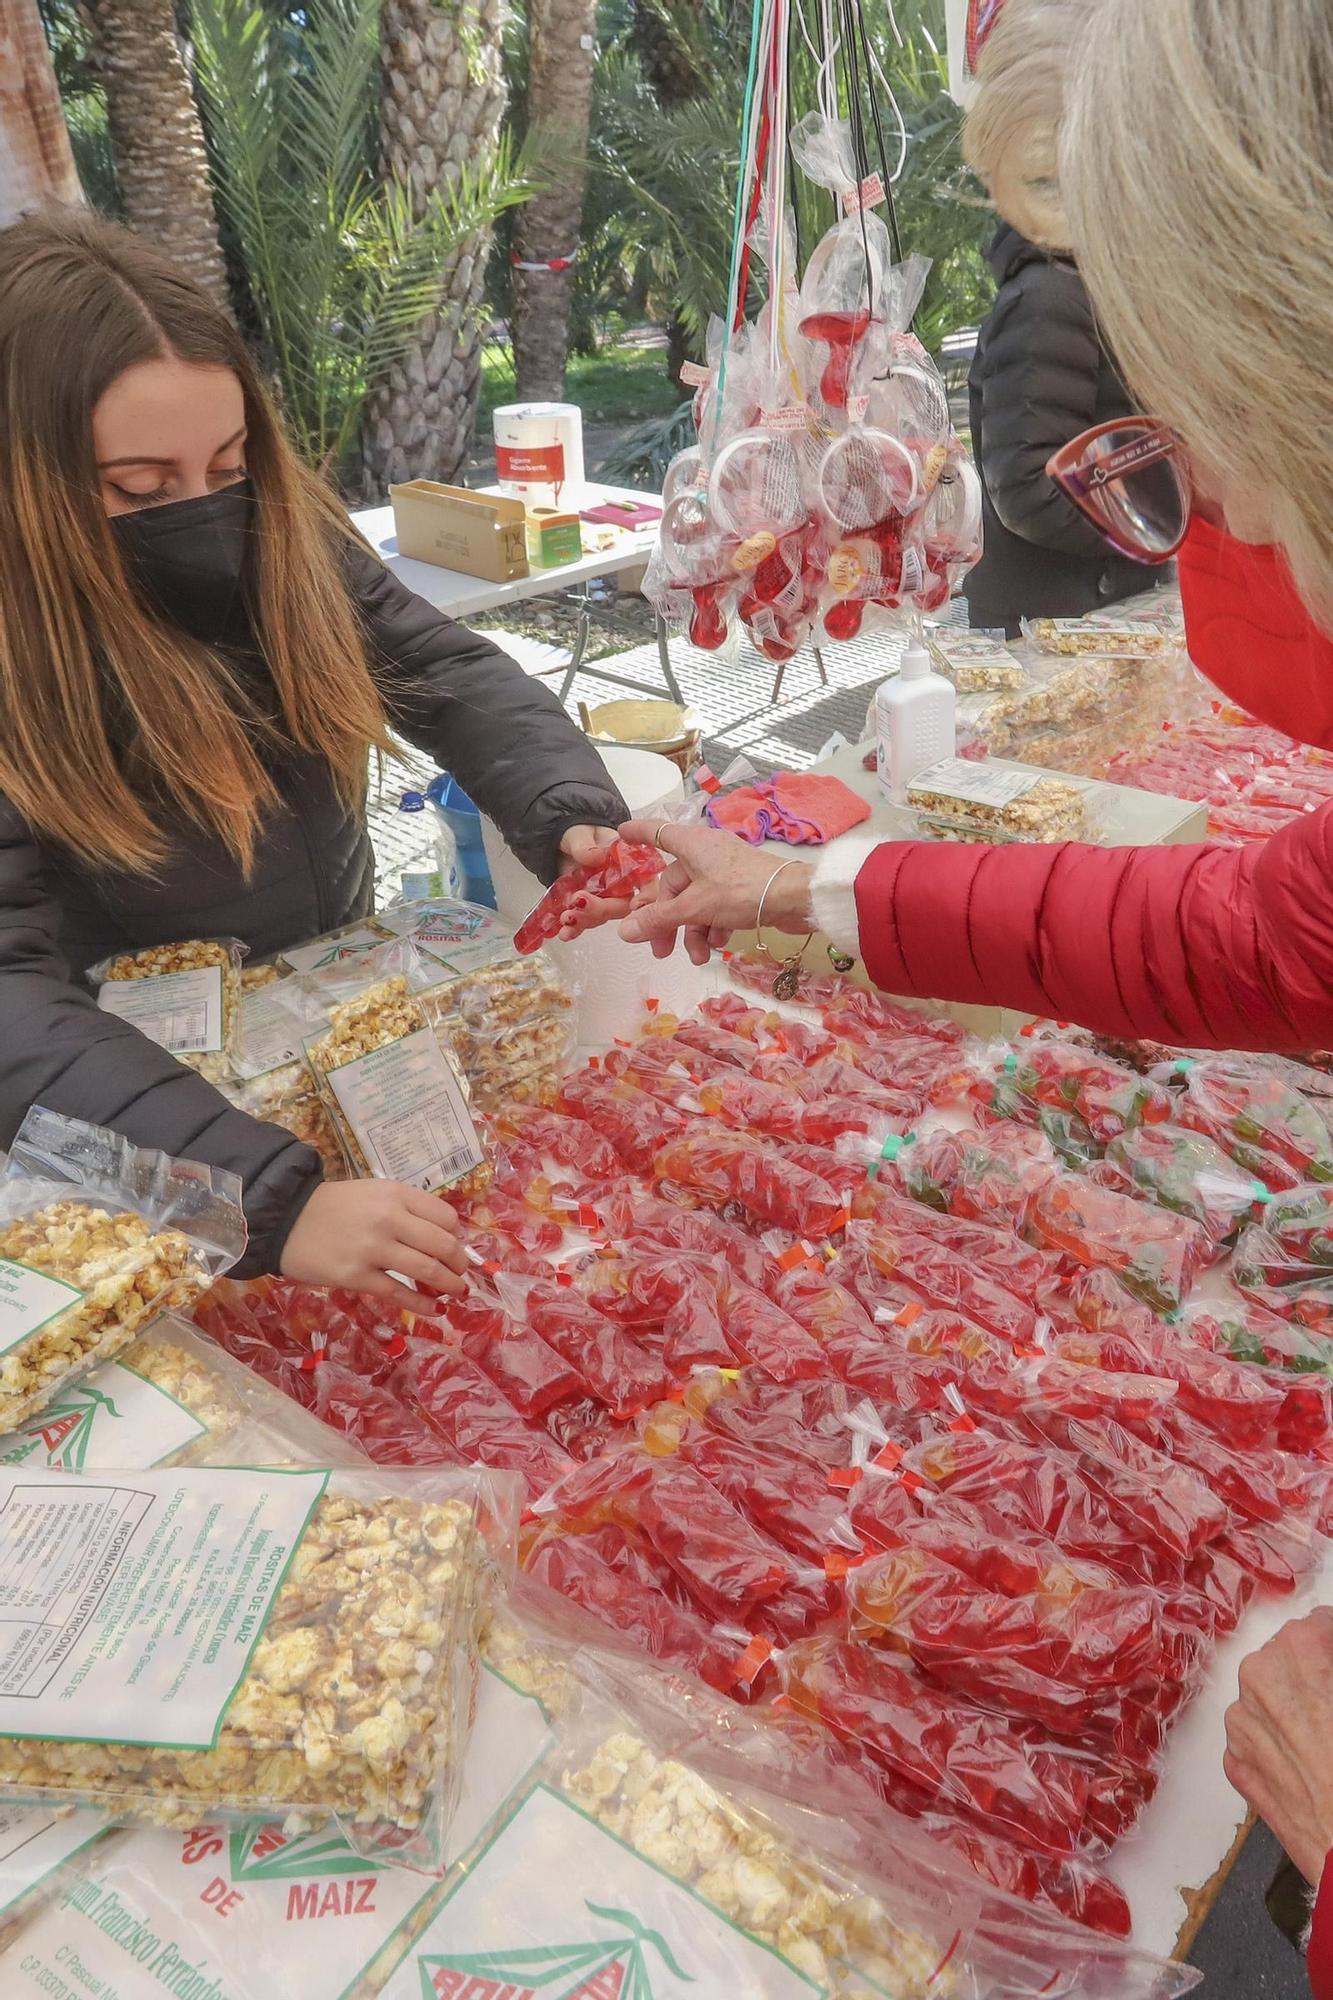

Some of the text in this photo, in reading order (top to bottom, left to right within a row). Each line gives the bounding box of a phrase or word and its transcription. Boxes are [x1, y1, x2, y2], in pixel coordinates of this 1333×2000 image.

[419, 934, 461, 942] ROSITAS
[44, 1522, 133, 1663] INFORMACIÓN NUTRICIONAL
[233, 1556, 260, 1591] Francisco
[90, 1558, 150, 1651] PREFERENTEMENTE
[233, 1546, 285, 1645] ROSITAS DE MAÍZ
[70, 1654, 96, 1683] ANTES
[202, 1634, 225, 1664] Conesa
[200, 1876, 377, 1920] DE MAIZ
[88, 1891, 161, 1963] Francisco
[65, 1954, 107, 1993] Pascual
